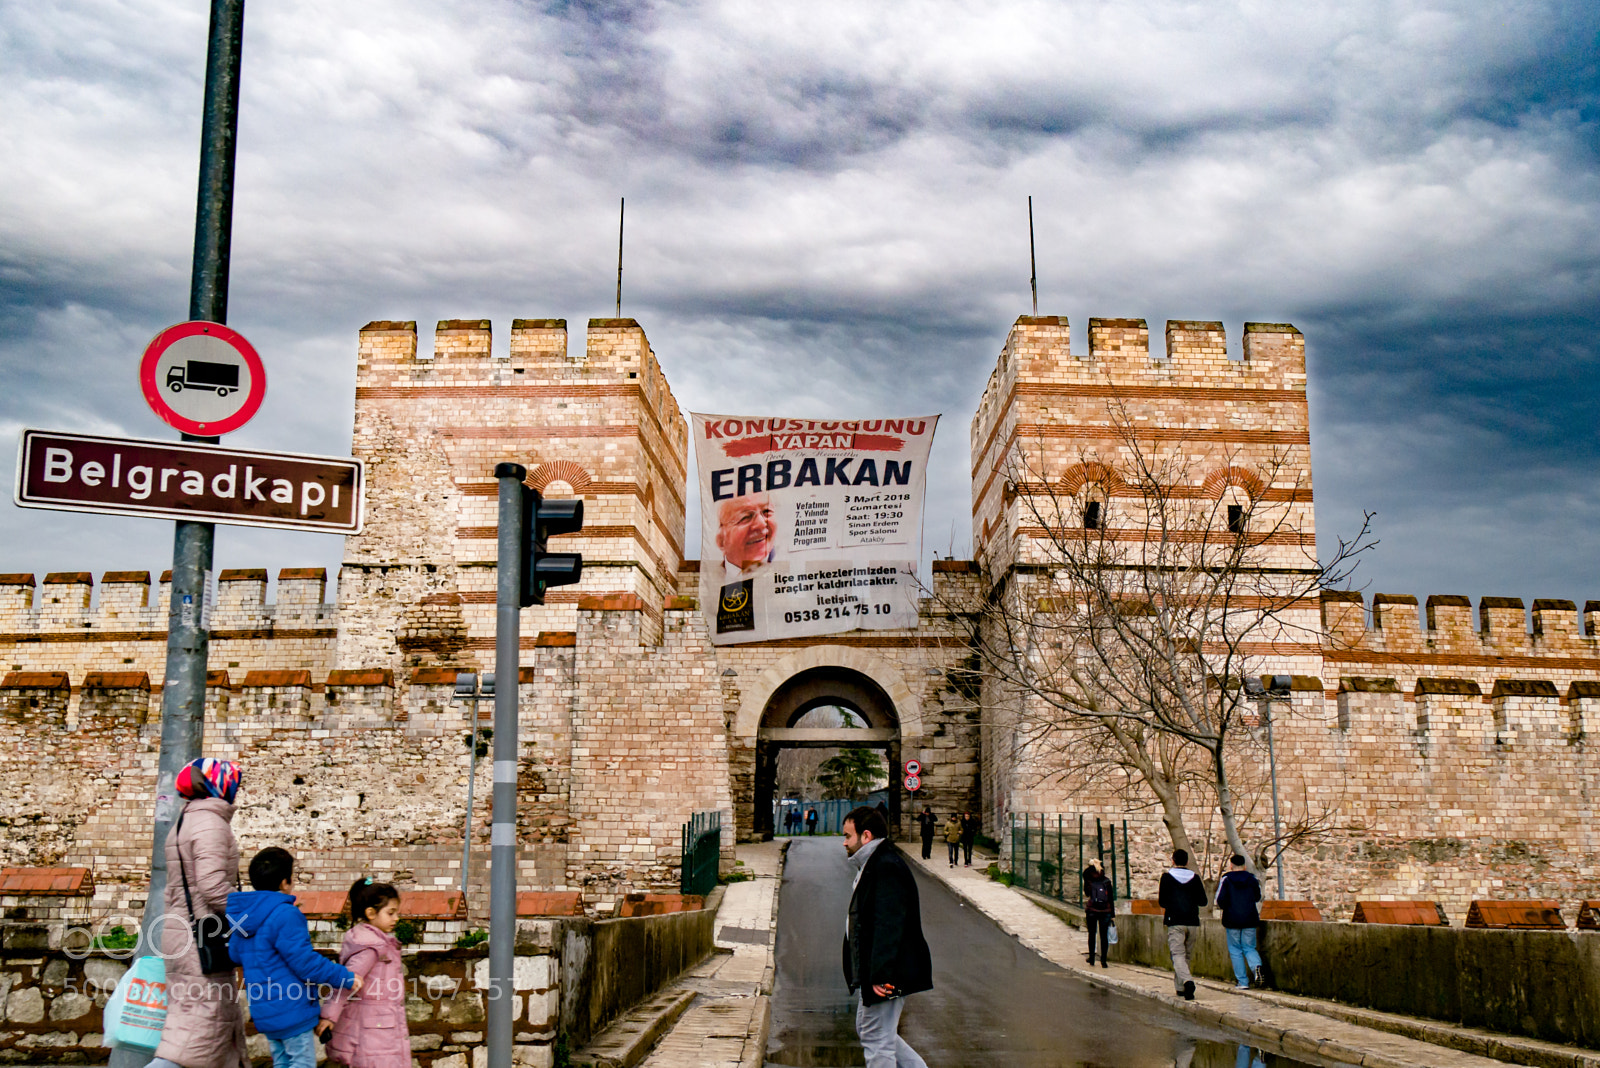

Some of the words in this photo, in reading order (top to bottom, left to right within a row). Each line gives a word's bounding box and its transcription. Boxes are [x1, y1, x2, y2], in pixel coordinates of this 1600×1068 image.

[774, 435, 852, 450] YAPAN
[43, 447, 340, 516] Belgradkapı
[711, 457, 912, 502] ERBAKAN
[854, 495, 880, 503] Mart
[850, 503, 902, 511] Cumartesi
[874, 511, 903, 520] 19:30
[795, 518, 817, 527] Anma
[794, 527, 827, 537] Anlama
[775, 583, 814, 594] araçlar
[784, 610, 820, 623] 0538
[825, 606, 850, 619] 214
[854, 604, 869, 615] 75
[874, 604, 891, 615] 10
